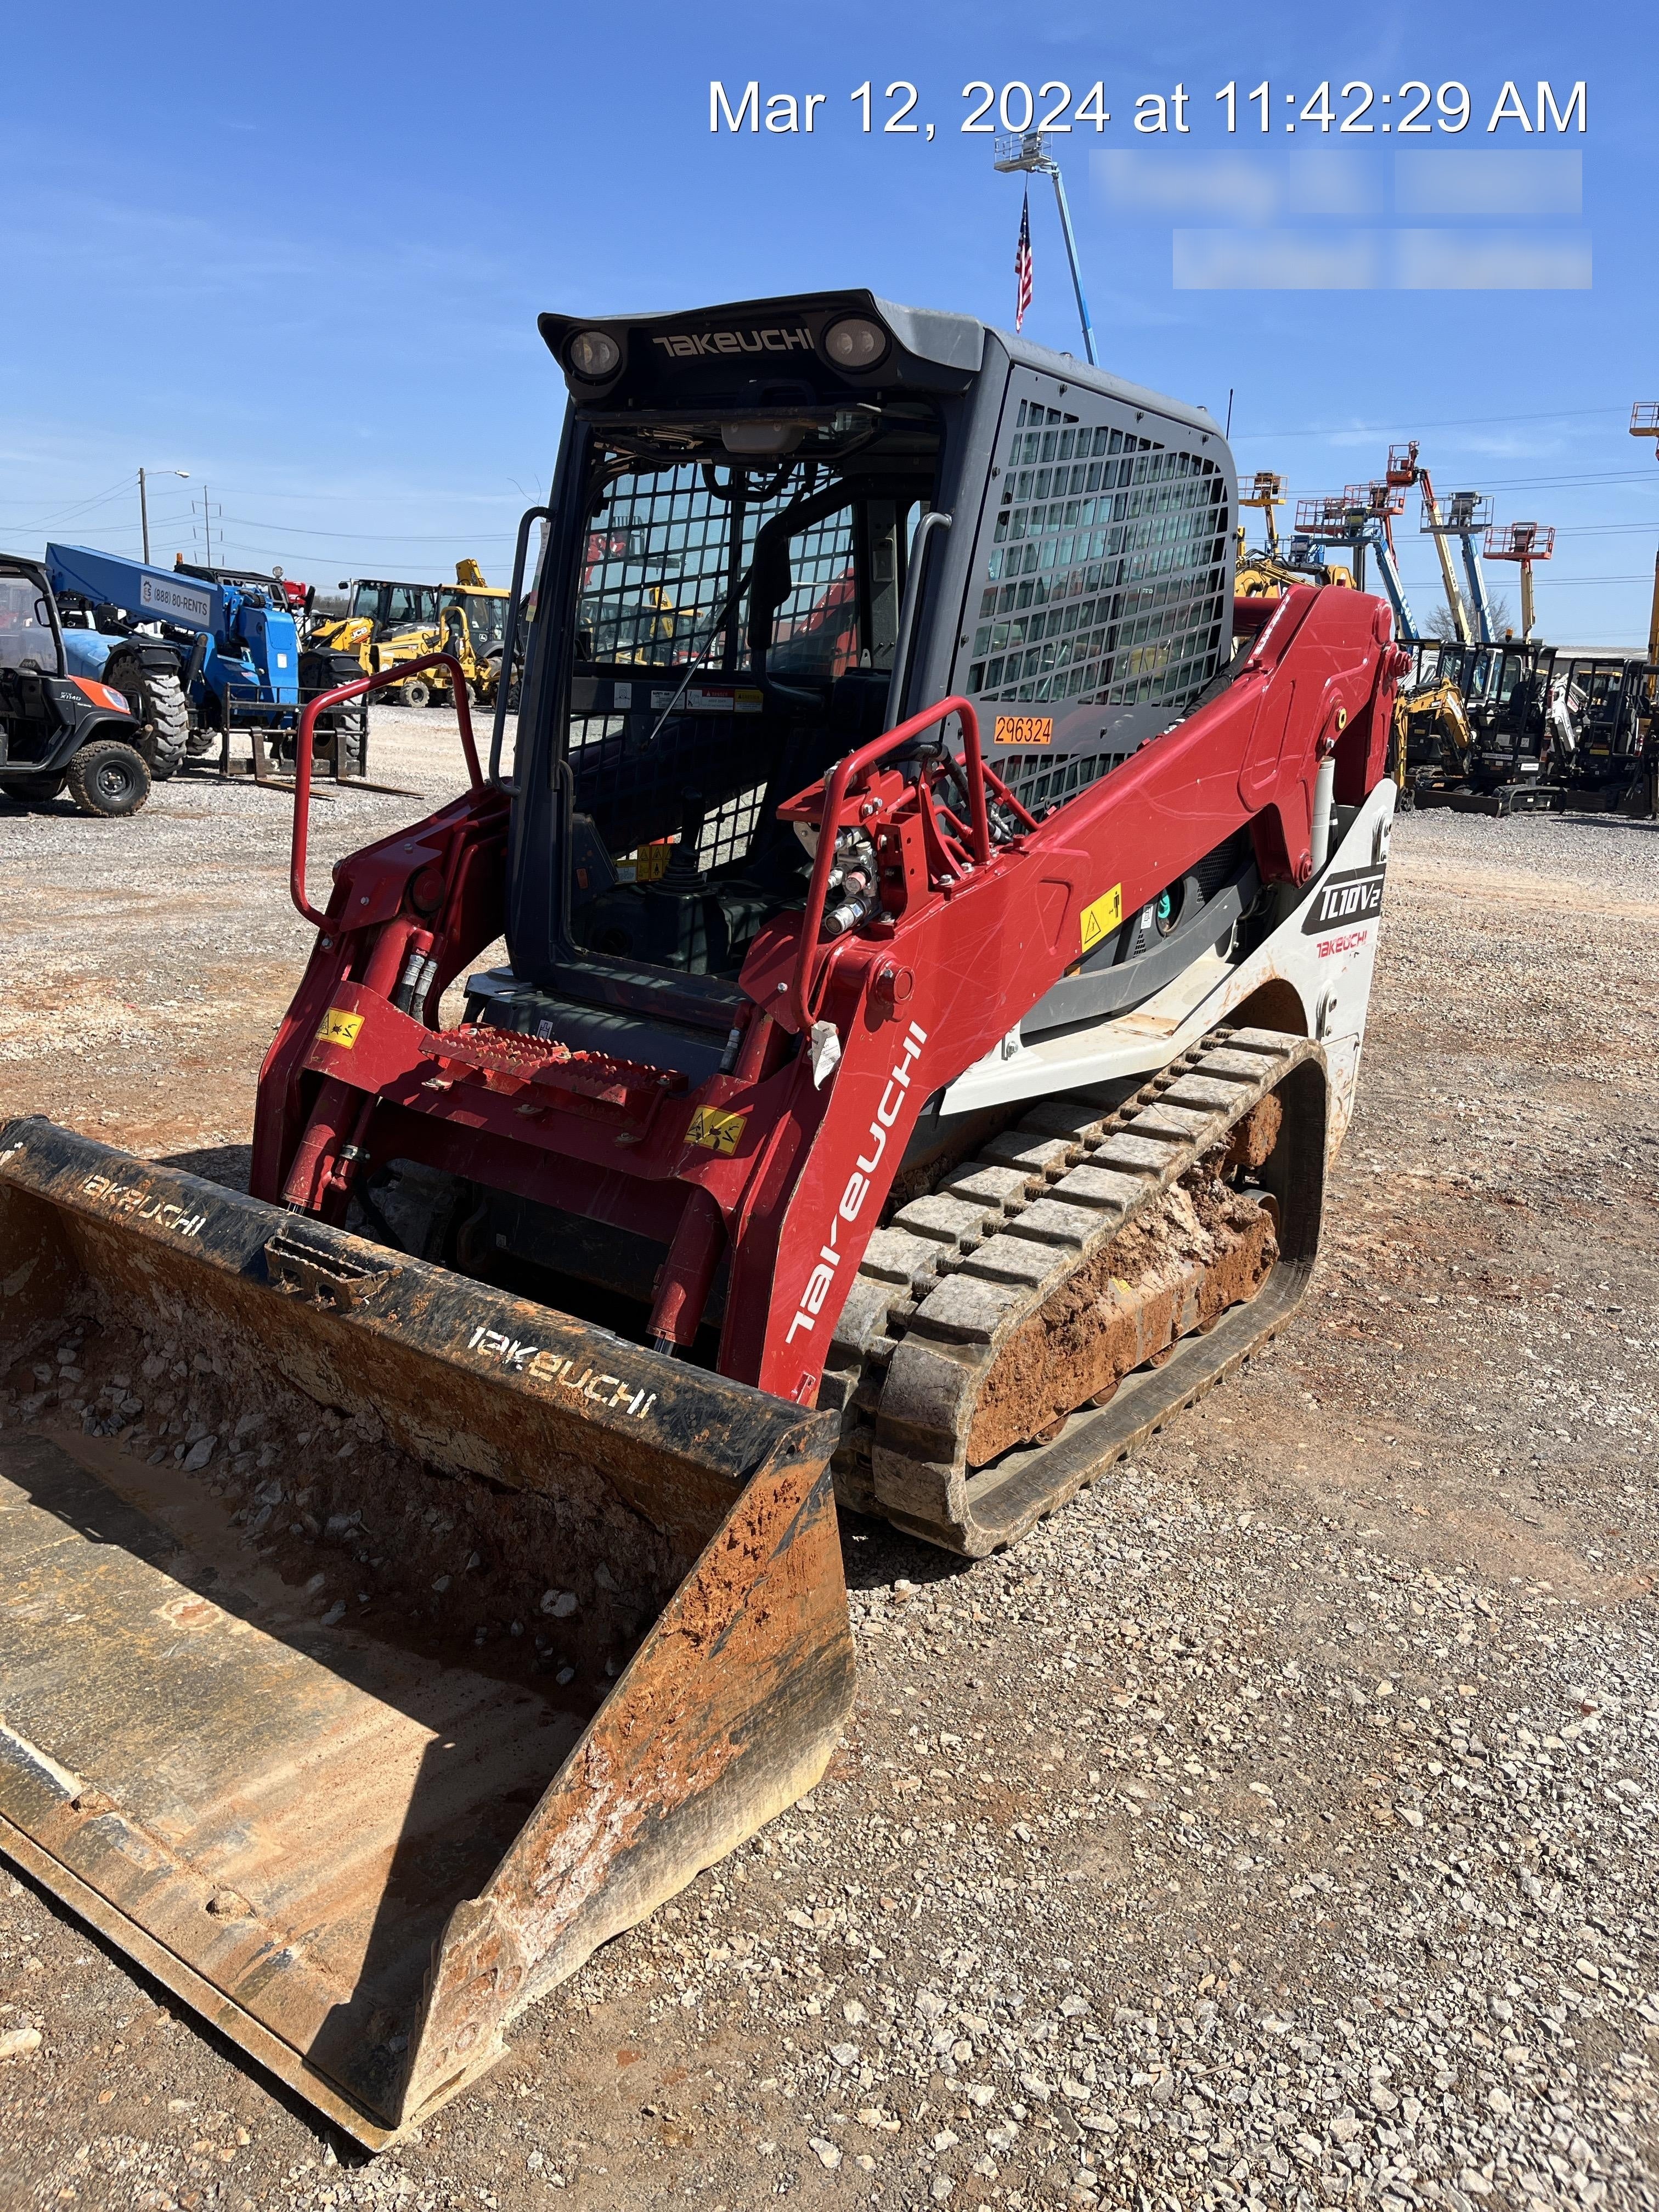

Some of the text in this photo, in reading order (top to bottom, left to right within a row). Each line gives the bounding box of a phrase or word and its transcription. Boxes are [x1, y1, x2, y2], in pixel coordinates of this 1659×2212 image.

[154, 587, 207, 616] (888) 80-RENTS
[351, 625, 369, 640] JCB
[995, 716, 1051, 743] 296324
